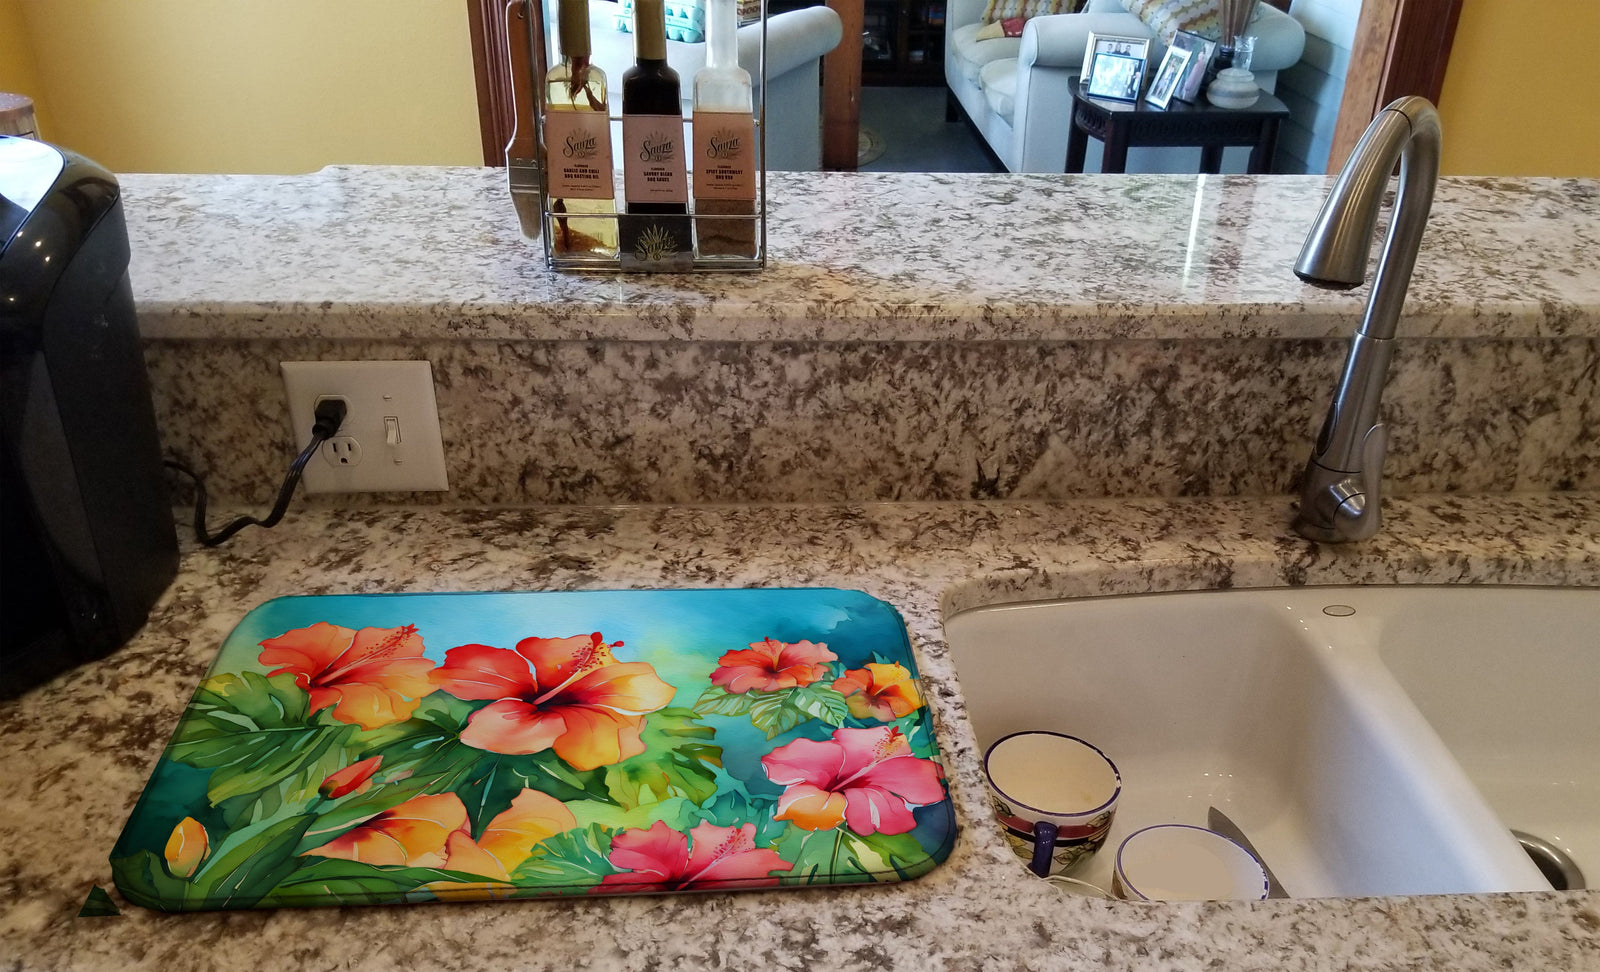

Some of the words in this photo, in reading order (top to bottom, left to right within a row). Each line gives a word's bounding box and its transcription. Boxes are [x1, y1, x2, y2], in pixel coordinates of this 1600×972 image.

[563, 135, 598, 158] Sauza
[640, 140, 673, 162] Sauza
[706, 136, 741, 159] Sauza
